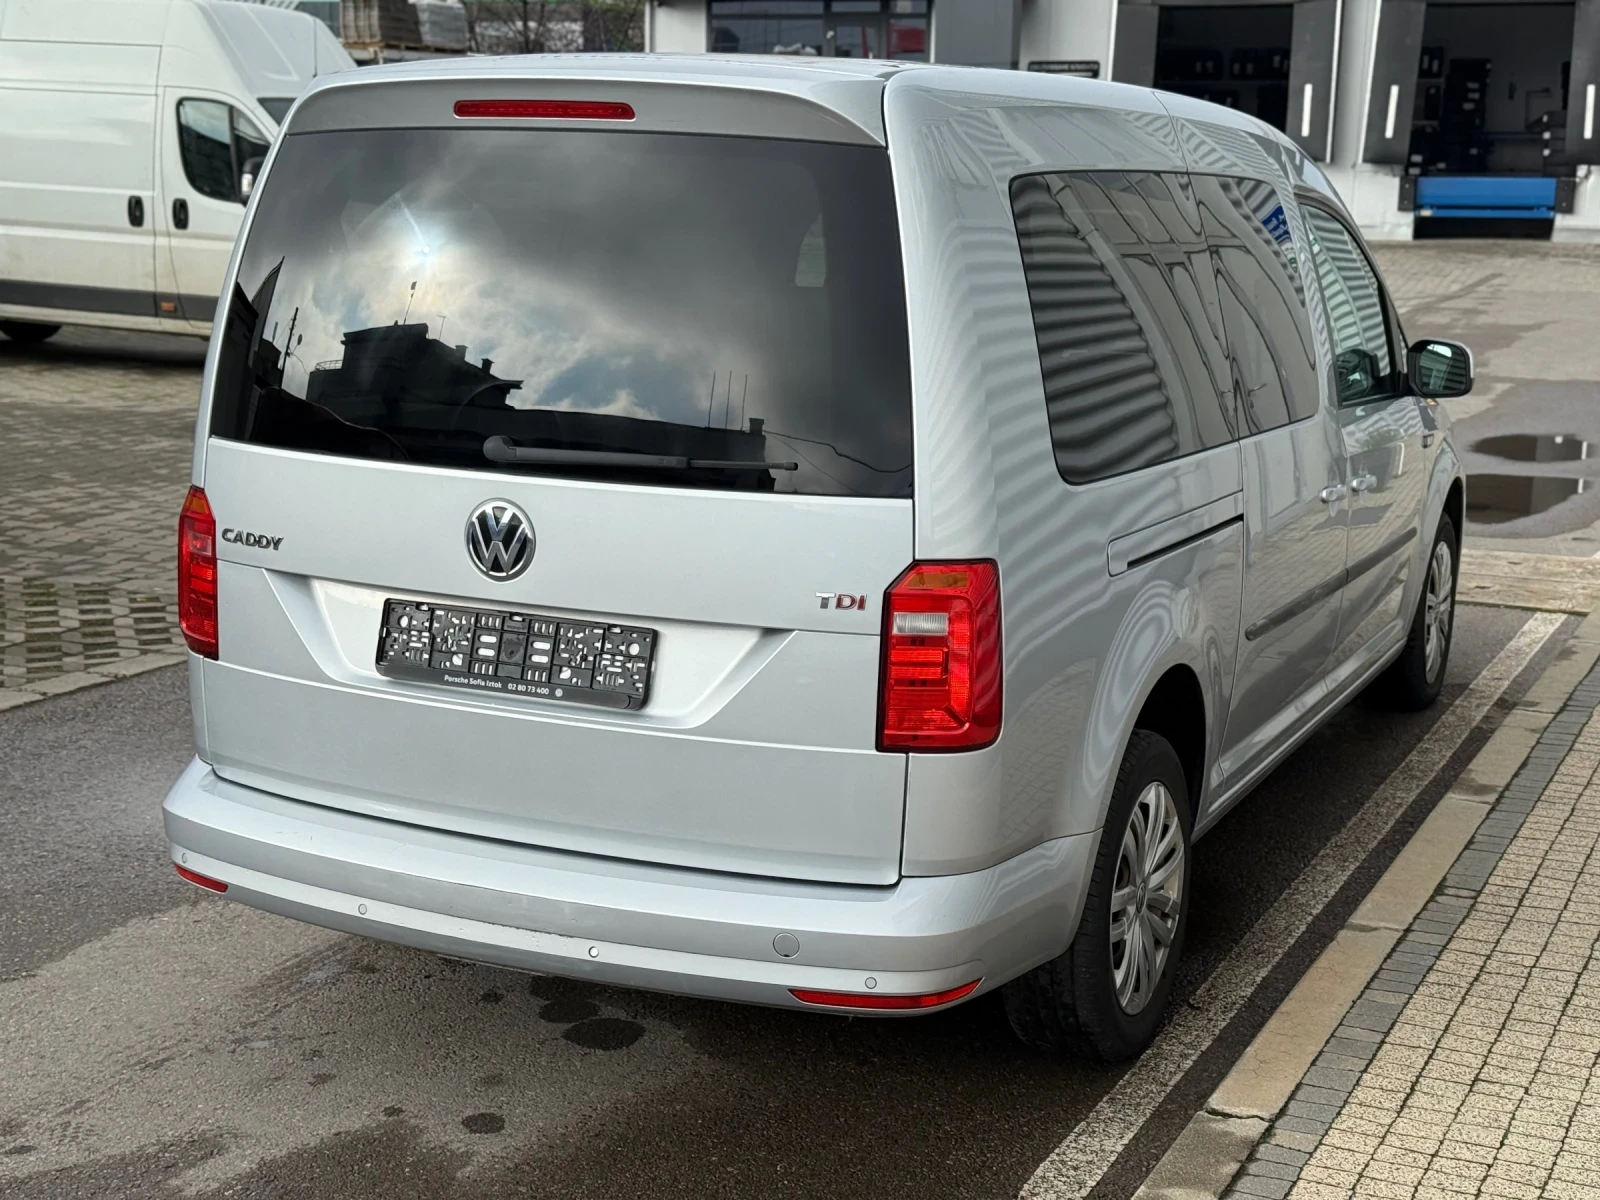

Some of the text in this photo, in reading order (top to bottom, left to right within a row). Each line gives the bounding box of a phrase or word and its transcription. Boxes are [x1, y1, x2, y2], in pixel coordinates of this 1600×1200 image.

[221, 527, 284, 551] CADDY
[467, 502, 532, 578] VW
[815, 591, 867, 611] TDI
[444, 674, 550, 695] Porsche Sofia Iztok 02 80 73 400
